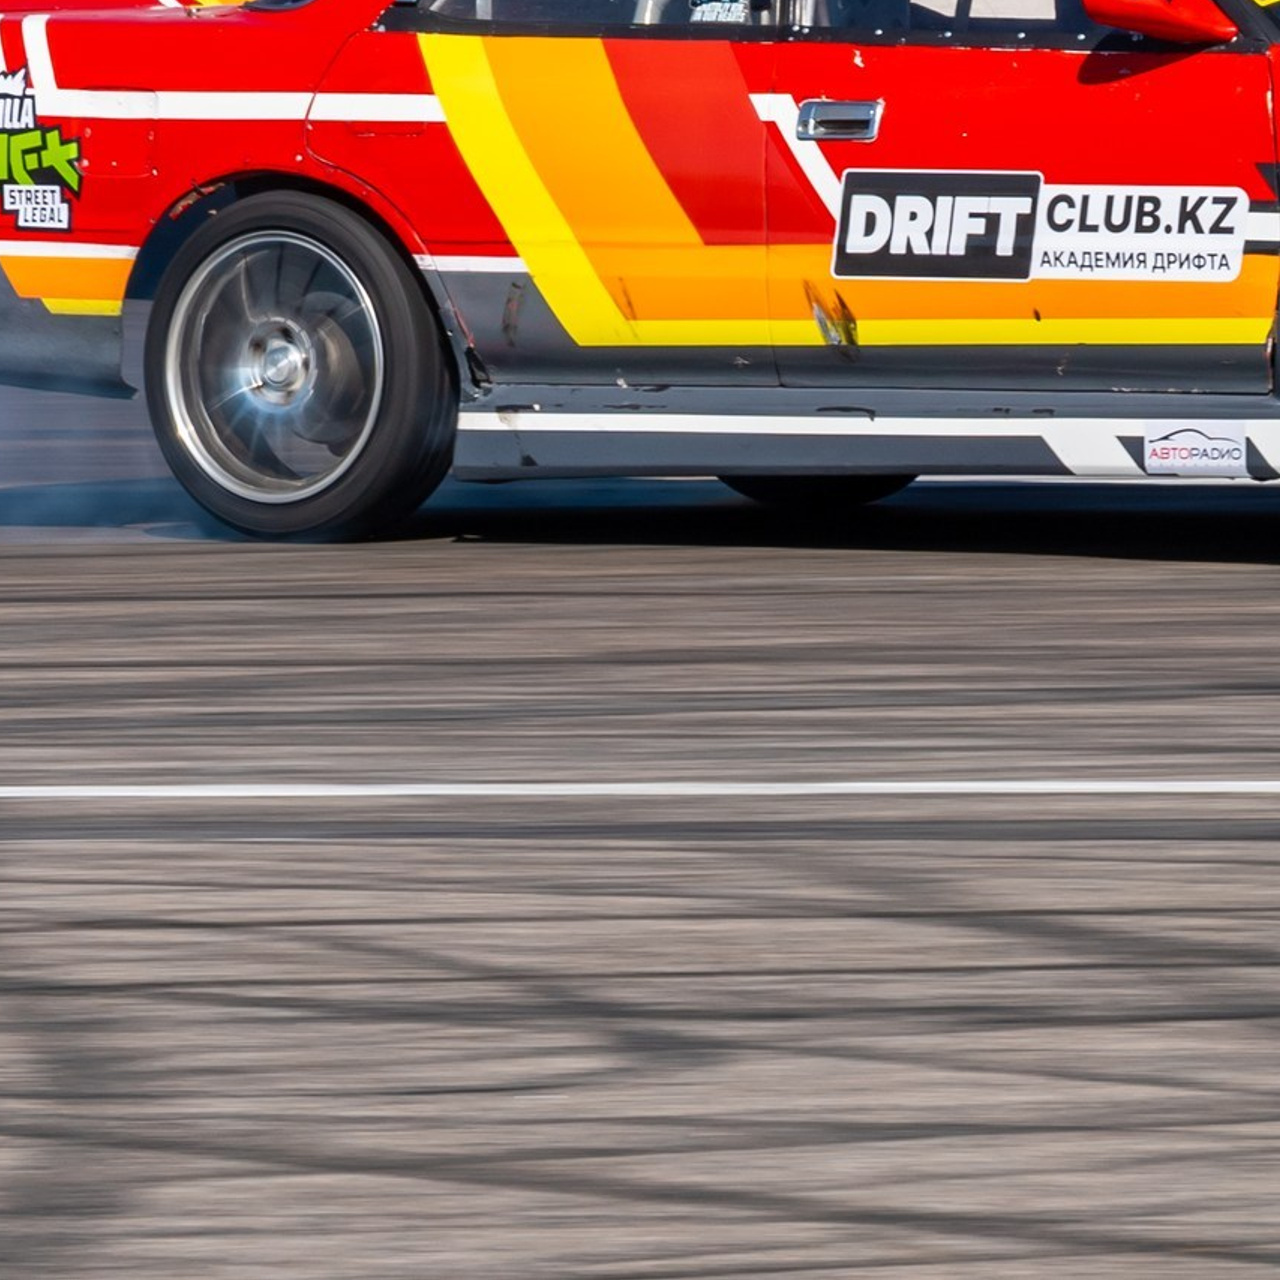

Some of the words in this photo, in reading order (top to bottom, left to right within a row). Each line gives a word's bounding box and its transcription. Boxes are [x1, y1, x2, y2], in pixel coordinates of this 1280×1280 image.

[9, 189, 57, 206] STREET
[24, 207, 63, 223] LEGAL
[846, 194, 1032, 257] DRIFT
[1046, 193, 1238, 235] CLUB.KZ
[1040, 250, 1147, 272] АКАДЕМИЯ
[1152, 252, 1230, 274] ДРИФТА
